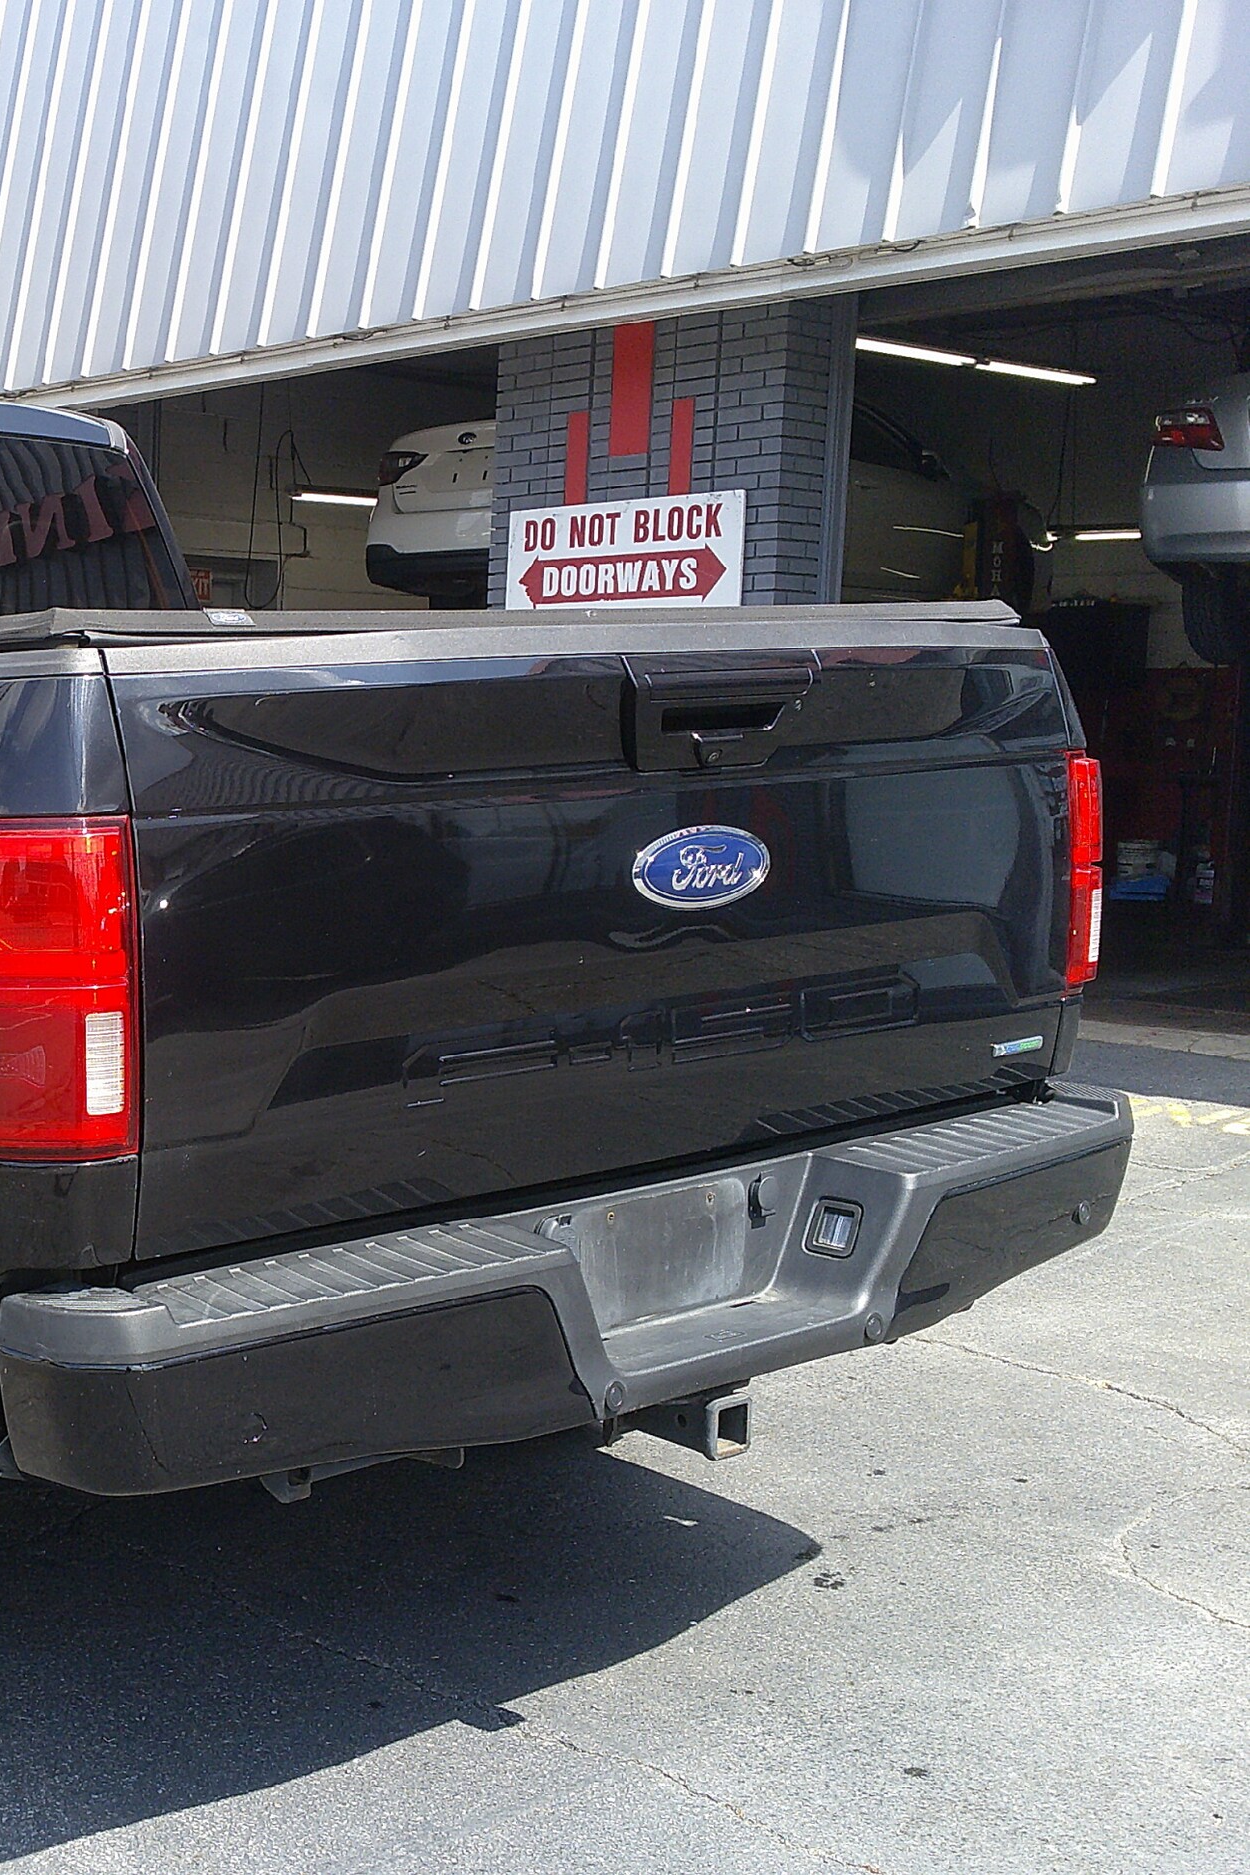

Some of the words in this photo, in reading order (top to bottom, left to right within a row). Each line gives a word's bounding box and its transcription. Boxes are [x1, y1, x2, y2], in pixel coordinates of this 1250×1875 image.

[524, 517, 556, 552] DO
[569, 512, 621, 548] NOT
[633, 503, 723, 543] BLOCK
[542, 557, 698, 597] DOORWAYS
[671, 845, 744, 891] Ford
